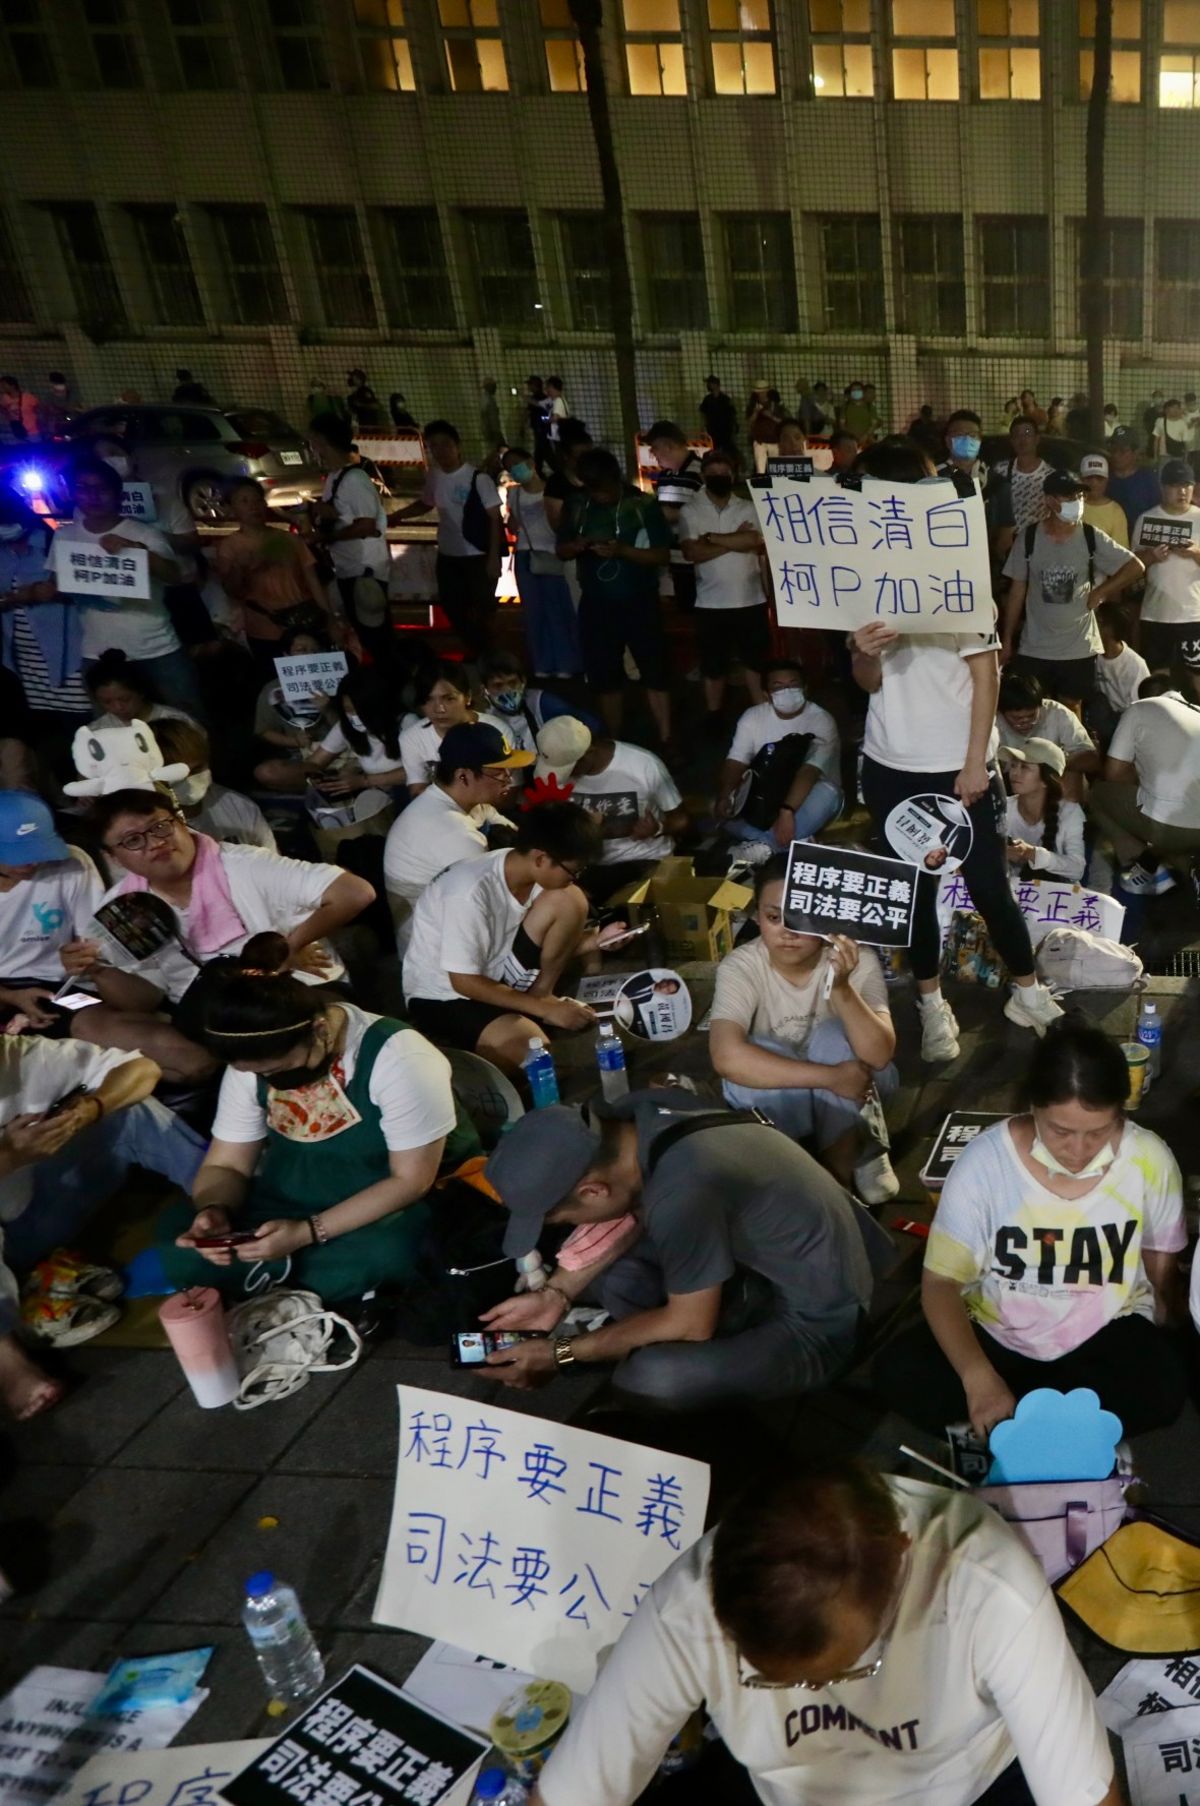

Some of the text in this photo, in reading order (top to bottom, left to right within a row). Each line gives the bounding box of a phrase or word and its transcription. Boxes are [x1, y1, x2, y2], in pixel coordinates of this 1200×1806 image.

[761, 491, 969, 549] 相信清白
[1143, 523, 1192, 537] 程序要正義
[70, 553, 136, 571] 相信清白
[74, 569, 136, 587] 柯P加油
[779, 561, 973, 614] 柯P加油
[792, 861, 911, 904] 程序要正義
[942, 874, 1102, 931] 程要正義
[790, 889, 908, 931] 司法要公平
[990, 1220, 1139, 1287] STAY
[405, 1410, 685, 1551] 程序要正義
[302, 1698, 454, 1805] 程序要正義
